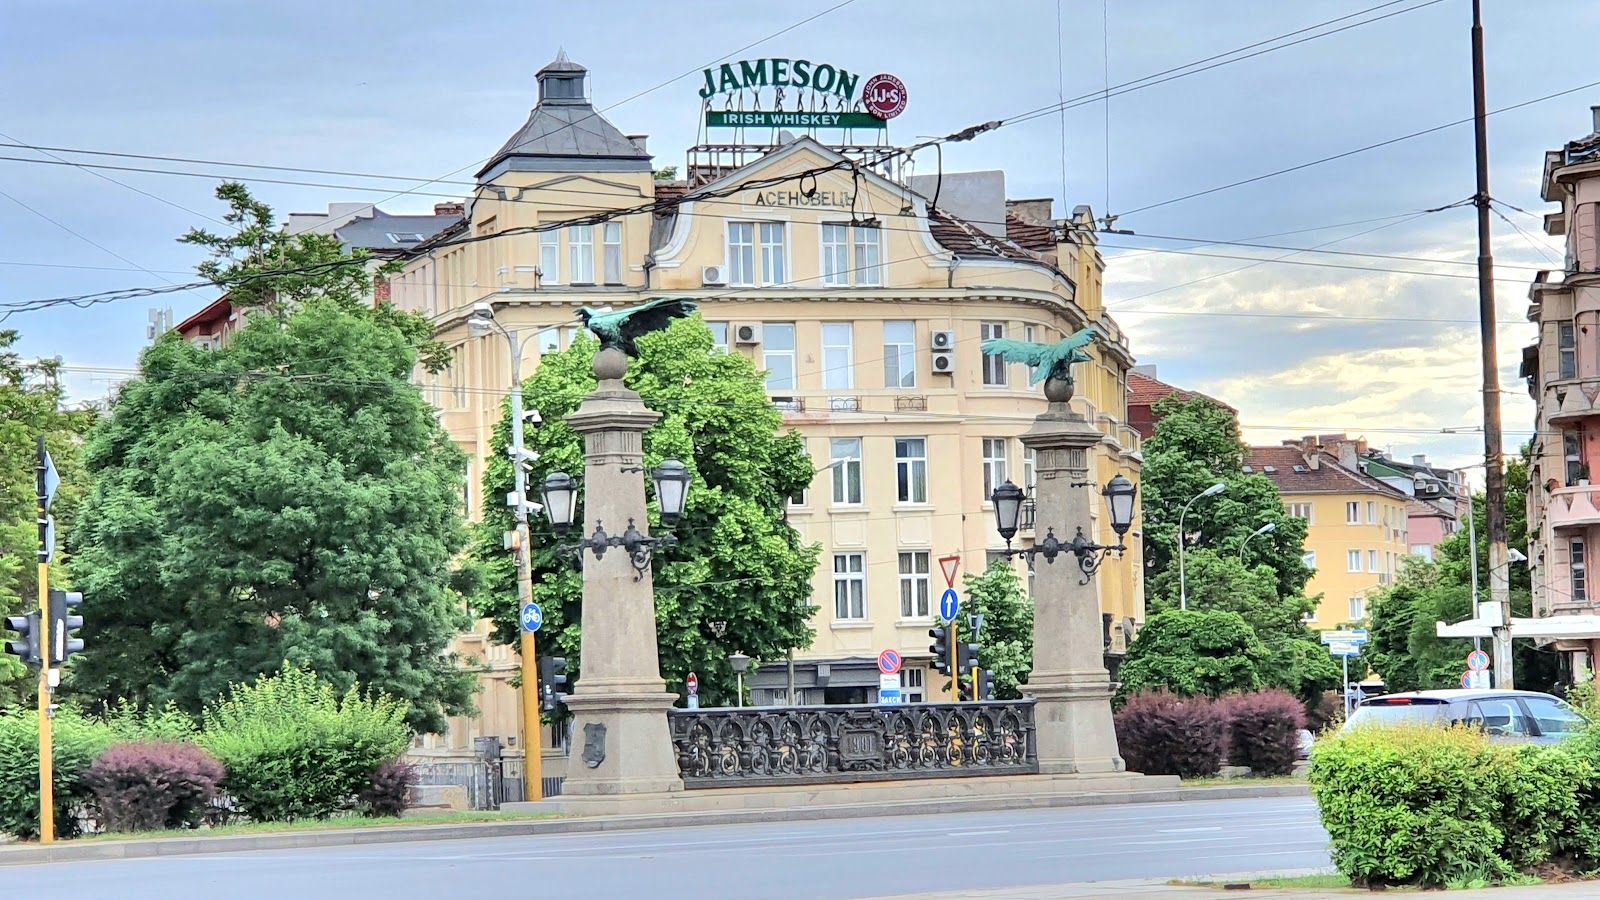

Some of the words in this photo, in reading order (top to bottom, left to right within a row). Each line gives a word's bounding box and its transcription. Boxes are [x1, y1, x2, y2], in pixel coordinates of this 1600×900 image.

[699, 58, 859, 101] JAMESON
[866, 77, 878, 94] JOHN
[723, 114, 765, 124] IRISH
[771, 114, 840, 125] WHISKEY
